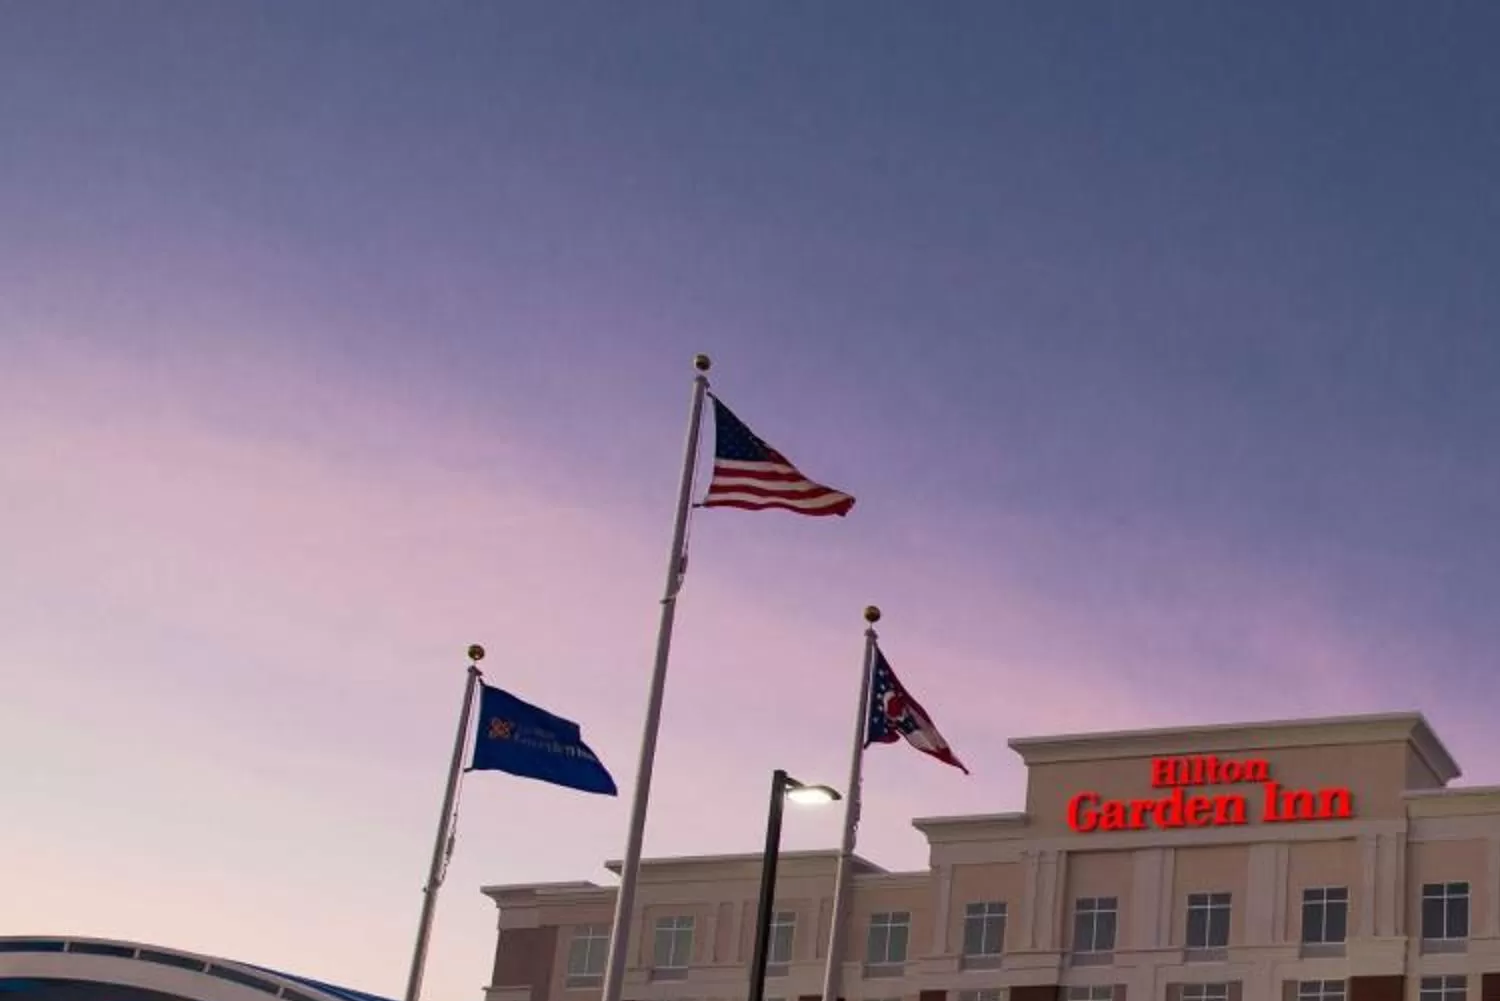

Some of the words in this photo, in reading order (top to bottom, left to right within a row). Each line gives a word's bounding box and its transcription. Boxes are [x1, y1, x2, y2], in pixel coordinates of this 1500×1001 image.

[1152, 754, 1269, 788] Hilton
[1067, 787, 1248, 833] Garden
[1263, 779, 1353, 823] Inn
